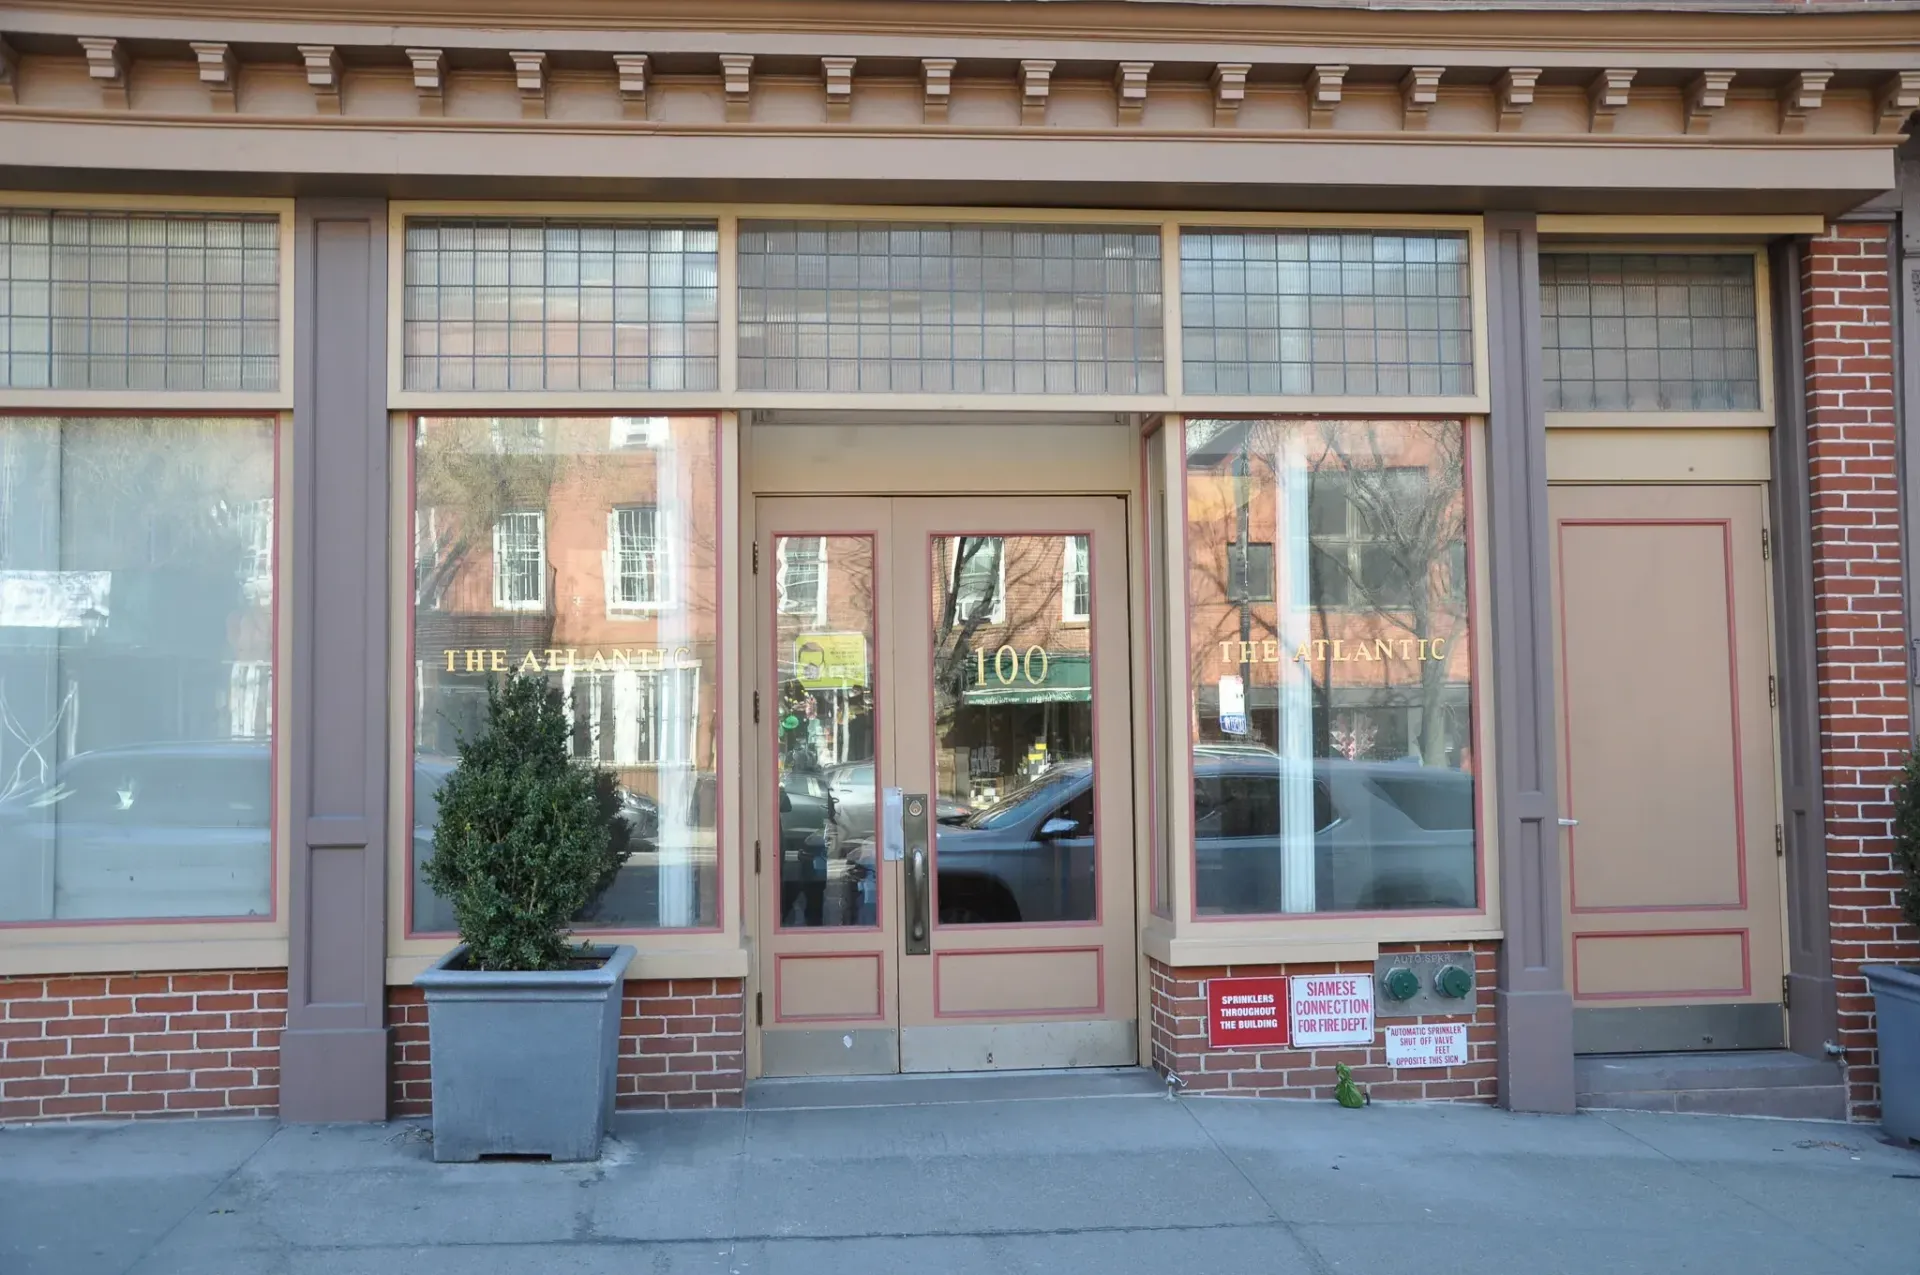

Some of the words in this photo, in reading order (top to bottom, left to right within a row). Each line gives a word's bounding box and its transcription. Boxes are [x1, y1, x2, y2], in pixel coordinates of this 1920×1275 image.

[1219, 640, 1279, 663] THE
[1294, 638, 1446, 662] ATLANTIC
[444, 649, 508, 672] THE
[518, 648, 691, 672] ATLANTIC
[975, 644, 1048, 687] 100
[1306, 980, 1357, 997] SIAMESE
[1221, 994, 1275, 1005] SPRINKLERS
[1220, 1006, 1277, 1017] THROUGHOUT
[1295, 998, 1370, 1016] CONNECTION
[1220, 1020, 1237, 1030] THE
[1238, 1019, 1278, 1029] BUILDING
[1297, 1019, 1317, 1033] FOR
[1318, 1018, 1340, 1032] FIRE
[1340, 1017, 1368, 1032] DEPT.
[1390, 1026, 1426, 1037] AUTOMATIC
[1427, 1025, 1463, 1036] SPRINKLER
[1400, 1037, 1416, 1047] SHUT
[1420, 1036, 1432, 1046] OFF
[1434, 1035, 1454, 1045] VALVE
[1435, 1045, 1451, 1055] FEET
[1396, 1056, 1427, 1066] OPPOSITE
[1428, 1055, 1444, 1065] THIS
[1444, 1055, 1459, 1064] SIGN
